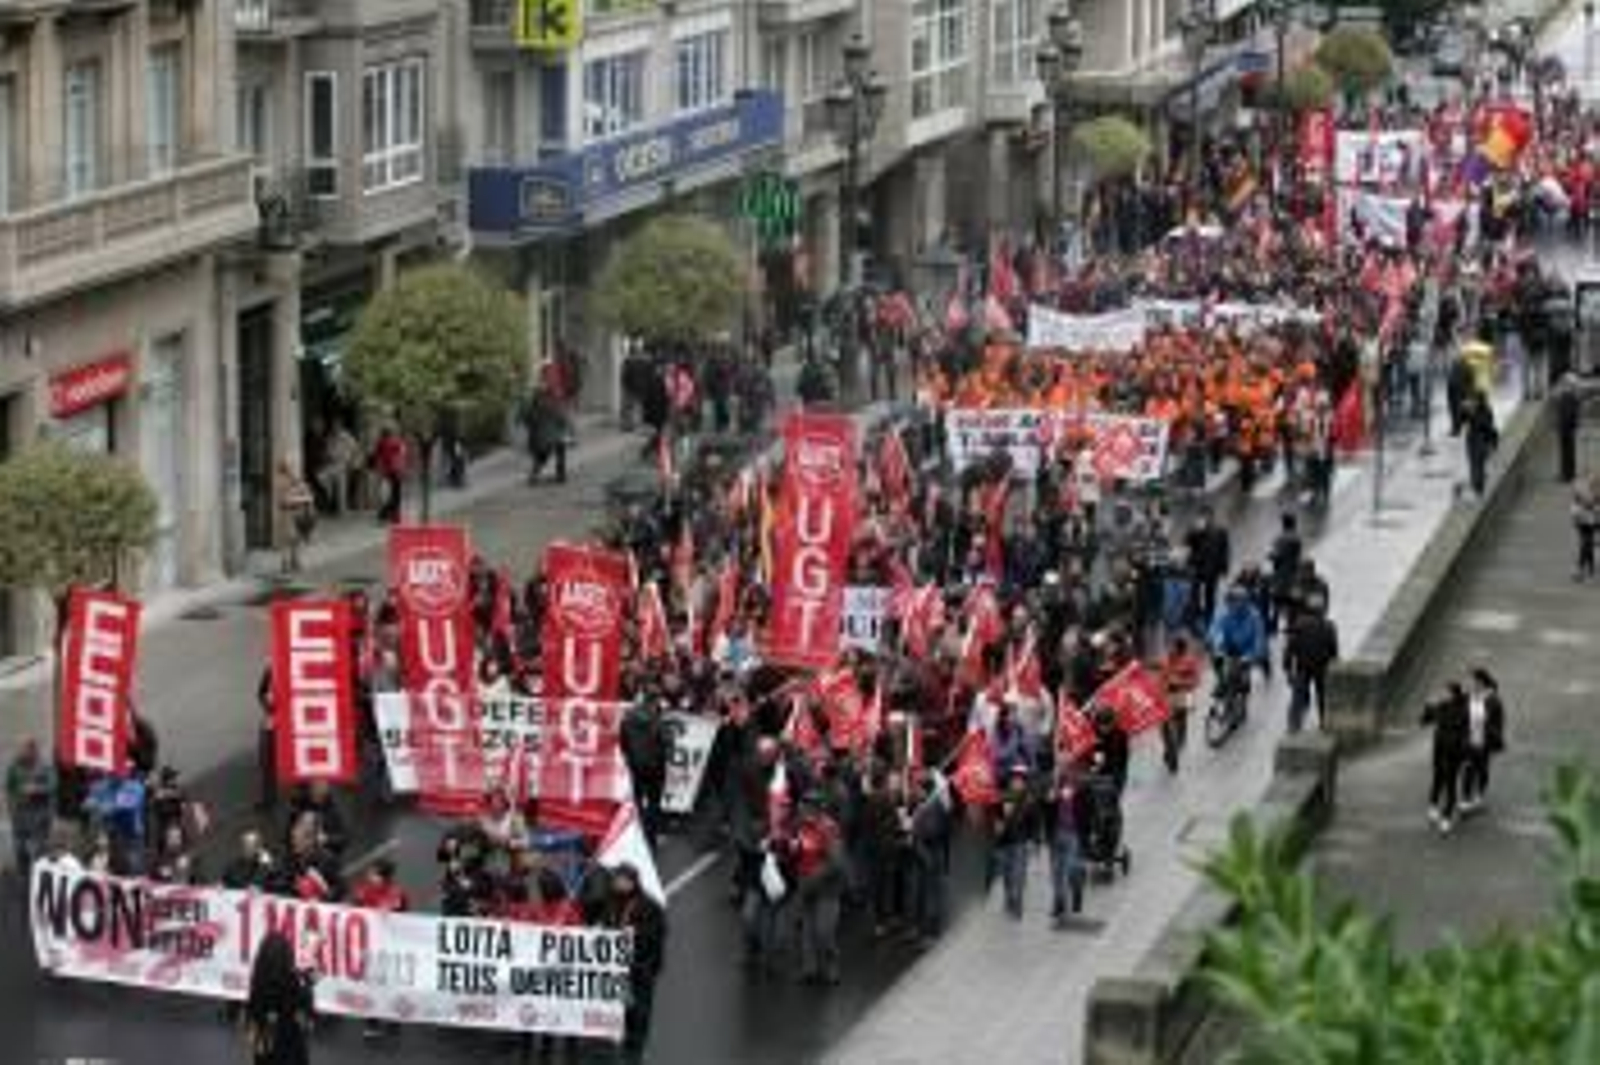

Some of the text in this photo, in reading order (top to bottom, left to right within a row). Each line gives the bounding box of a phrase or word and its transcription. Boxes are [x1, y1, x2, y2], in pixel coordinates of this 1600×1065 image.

[788, 497, 832, 656] UGT
[75, 600, 128, 769] CCOO
[289, 609, 341, 777] CCOO
[418, 618, 468, 788] UGT
[561, 635, 602, 805] UGT
[37, 870, 145, 949] NON
[236, 896, 253, 963] 1
[263, 900, 370, 982] MAIO
[437, 960, 498, 996] TEUS
[438, 921, 633, 966] LOITA POLOS
